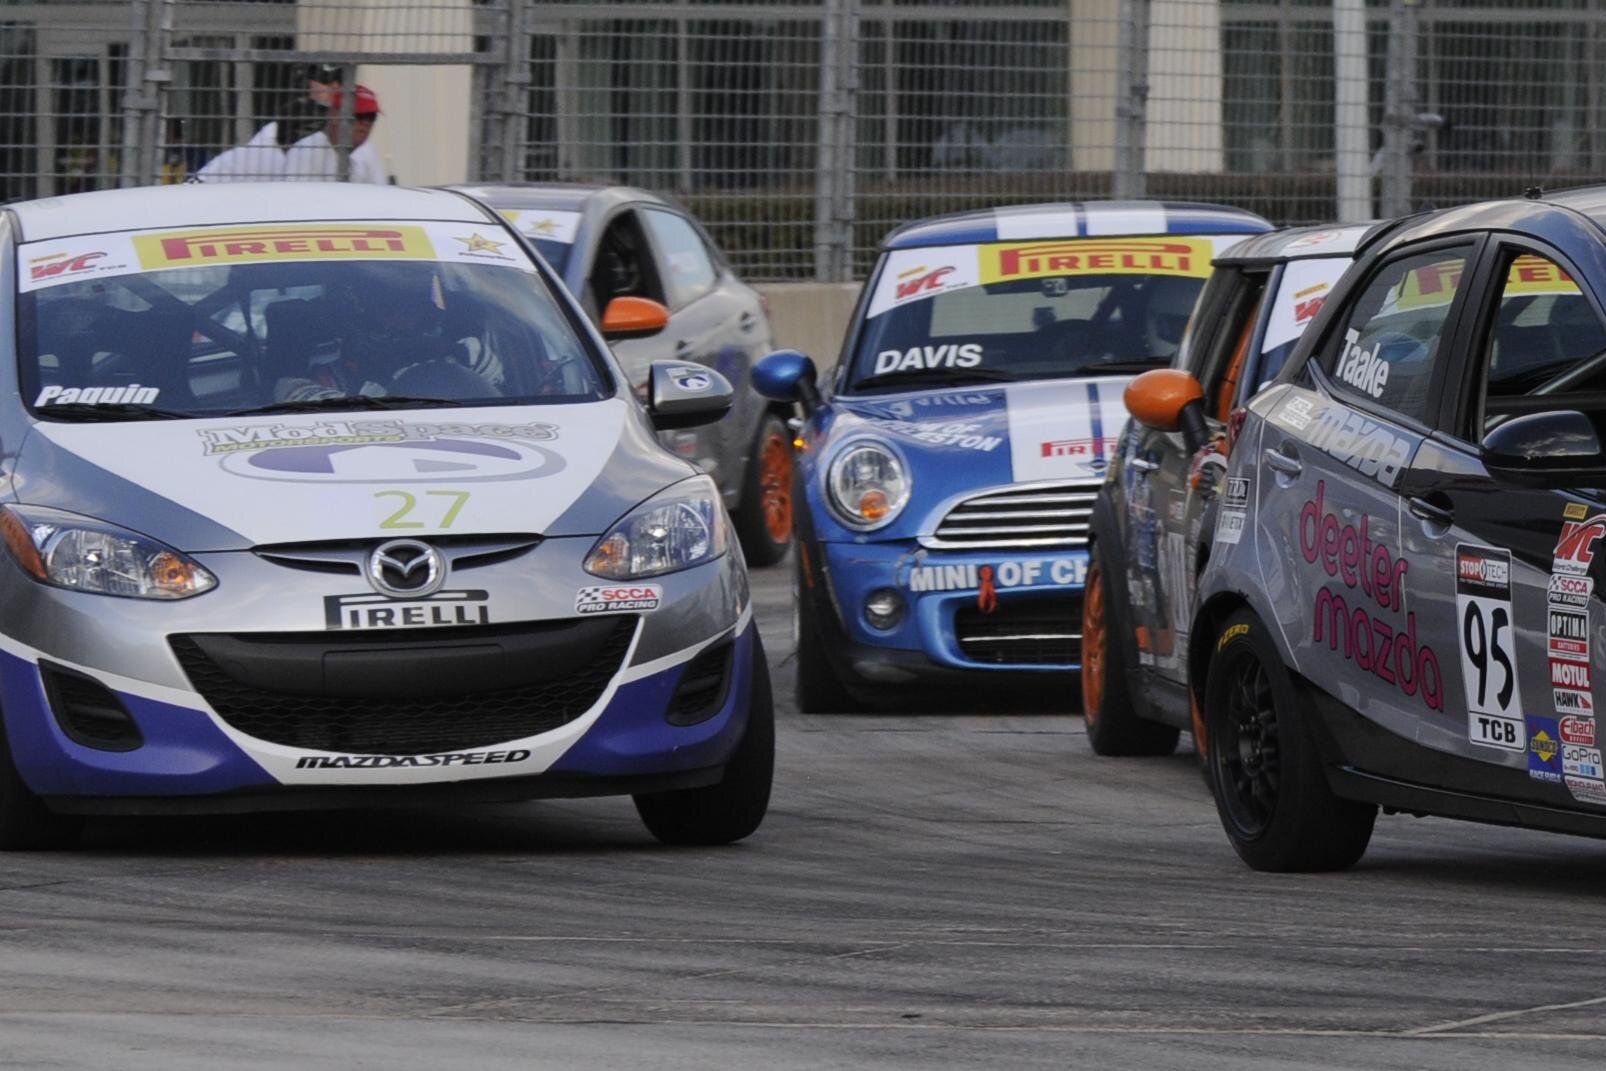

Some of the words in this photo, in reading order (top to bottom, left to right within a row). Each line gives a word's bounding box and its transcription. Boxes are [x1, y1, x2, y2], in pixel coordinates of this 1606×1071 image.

[160, 230, 405, 260] PIRELLI
[31, 252, 107, 279] WC
[1001, 243, 1192, 275] PIRELLI
[1296, 294, 1328, 322] W
[874, 343, 982, 375] DAVIS
[1336, 328, 1390, 398] Taake
[34, 383, 160, 408] Paquin
[374, 490, 470, 528] 27
[1300, 480, 1408, 612] deeter
[910, 564, 978, 592] MINI
[998, 560, 1041, 586] OF
[1561, 579, 1588, 593] SCCA
[580, 602, 605, 612] PRO
[608, 600, 656, 610] RACING
[602, 588, 656, 600] SCCA
[323, 589, 489, 630] PIRELLI
[1551, 614, 1586, 638] OPTIMA
[1314, 586, 1444, 713] mazda
[1464, 599, 1514, 711] 95
[1552, 662, 1590, 687] MOTUL
[1555, 691, 1580, 708] HAWK
[1479, 718, 1516, 743] TCB
[1560, 717, 1594, 738] Eibach
[296, 749, 531, 770] MAZDASPEED
[1562, 745, 1601, 765] GoPro
